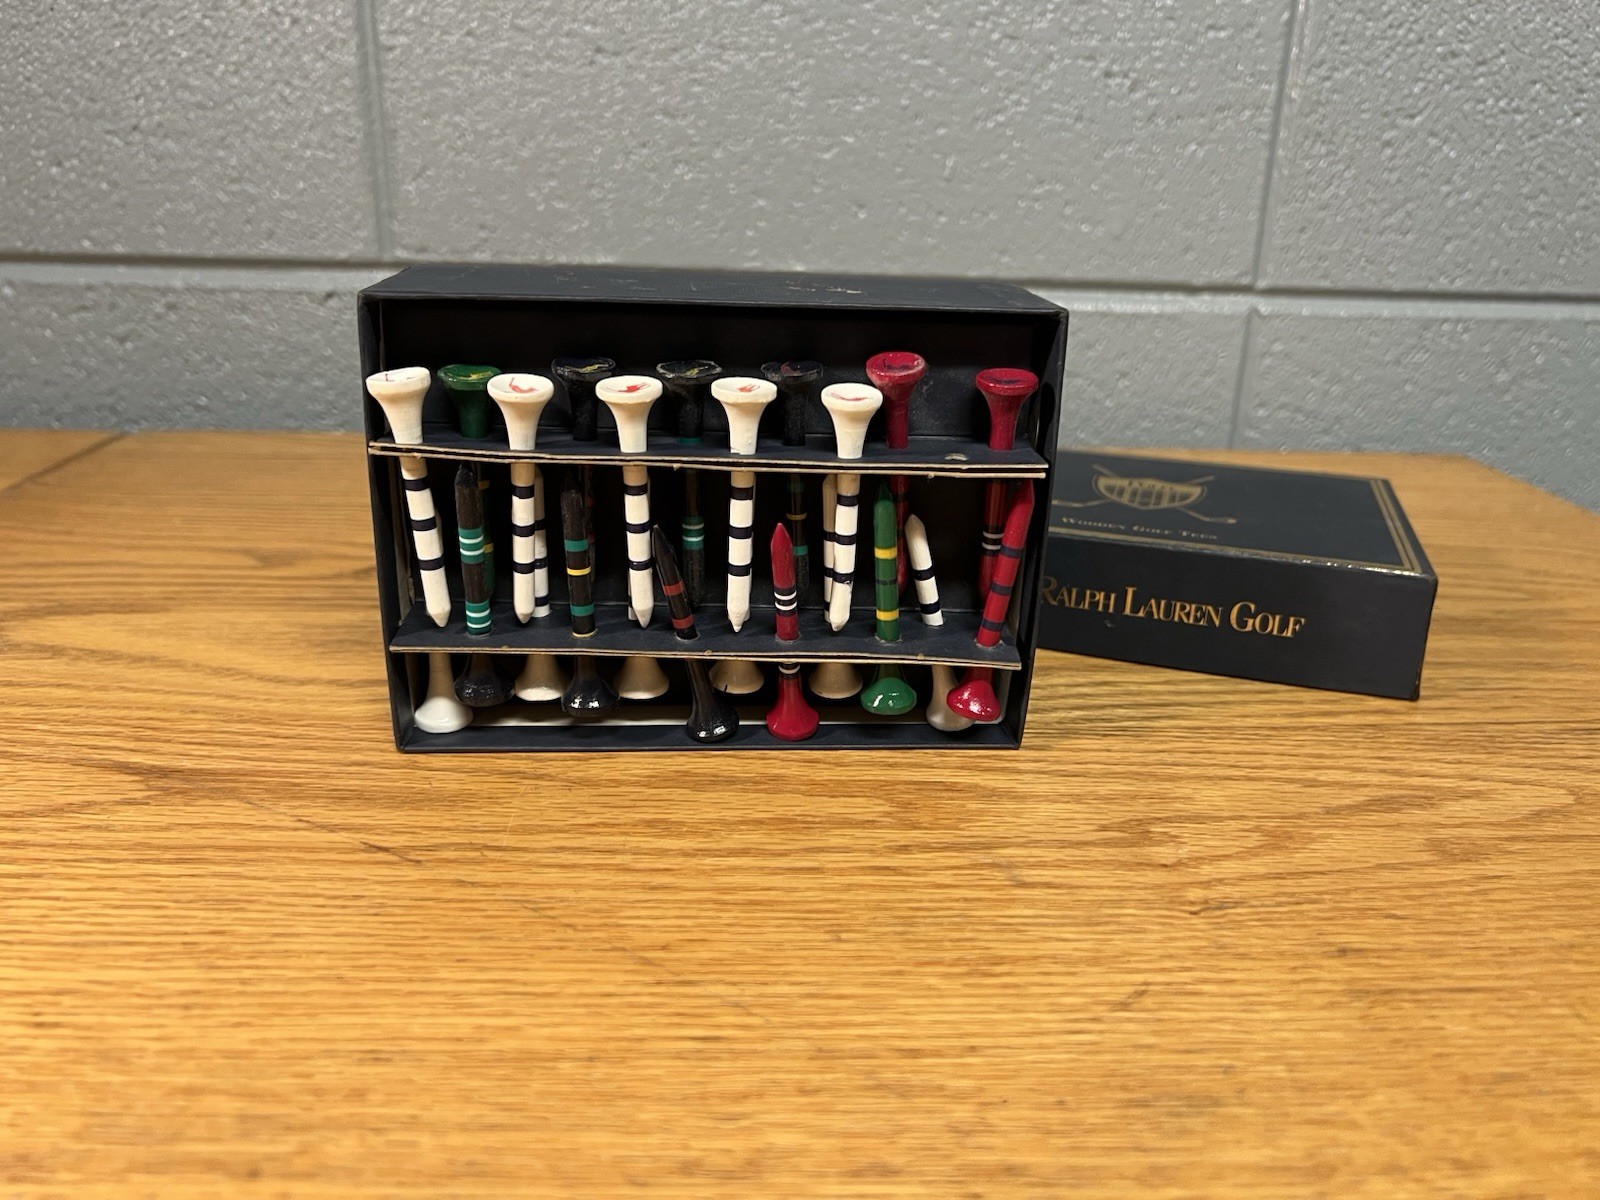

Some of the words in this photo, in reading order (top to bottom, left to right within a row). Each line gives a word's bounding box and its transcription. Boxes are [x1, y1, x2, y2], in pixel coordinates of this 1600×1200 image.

[1040, 576, 1118, 613] RALPH
[1123, 586, 1222, 627] LAUREN
[1230, 601, 1305, 638] GOLF
